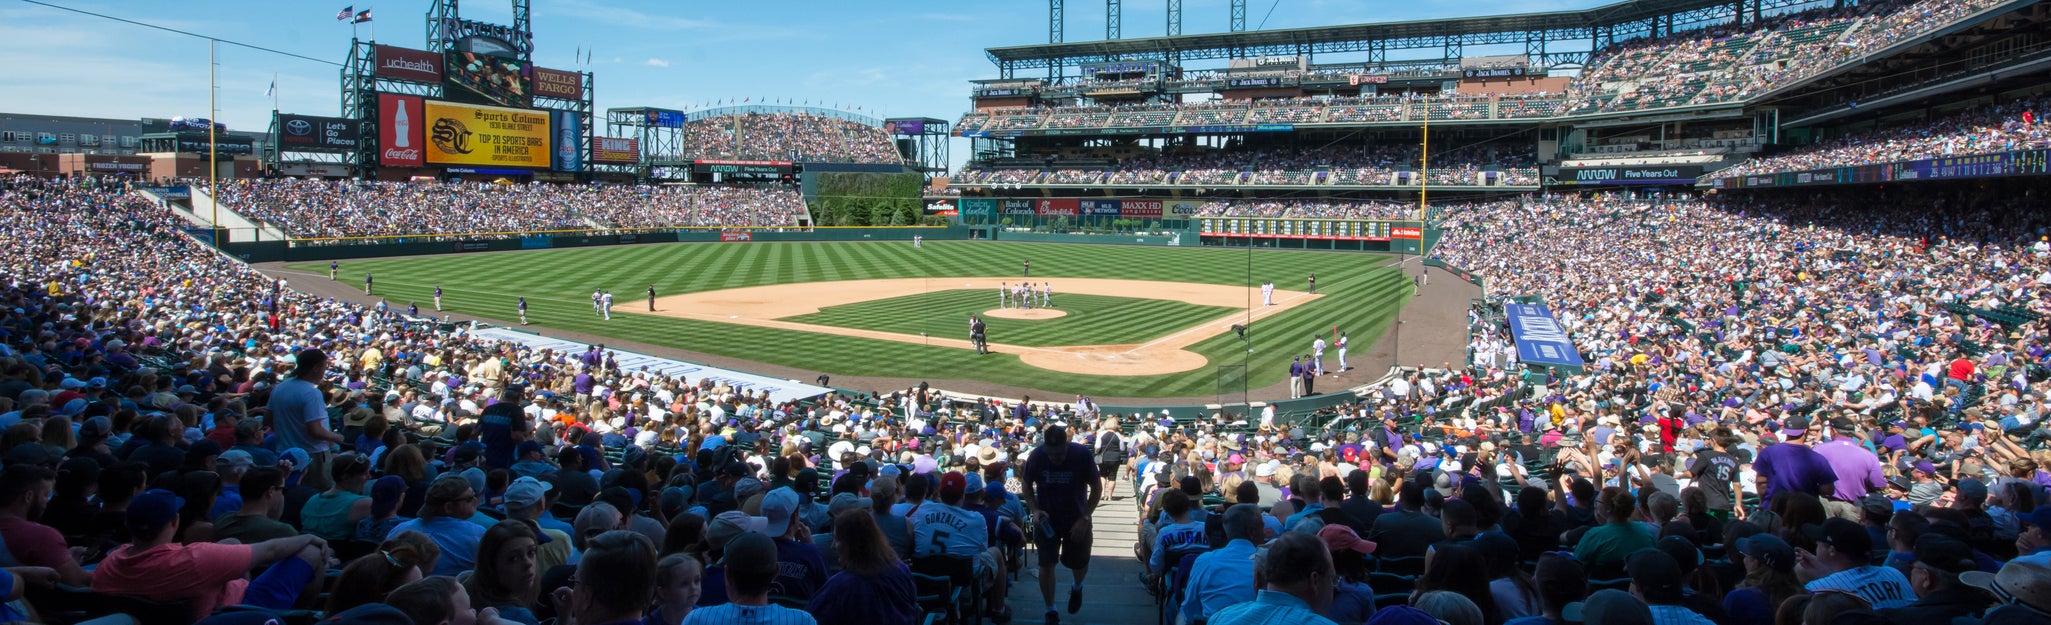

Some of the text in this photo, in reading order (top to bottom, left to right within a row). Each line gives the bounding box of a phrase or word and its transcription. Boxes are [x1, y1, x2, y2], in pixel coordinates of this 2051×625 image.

[386, 57, 434, 72] uchealth
[538, 72, 576, 86] WELLS
[539, 82, 576, 94] FARGO
[474, 110, 546, 125] Sports Column
[326, 122, 346, 130] Let's
[326, 138, 355, 146] Places
[479, 134, 543, 146] TOP 20 SPORTS BARS
[602, 139, 630, 150] KING
[494, 145, 528, 155] IN AMERICA
[1577, 170, 1616, 180] ARROW
[1663, 169, 1678, 177] Out
[925, 512, 968, 532] GONZALEZ
[929, 529, 950, 554] 5
